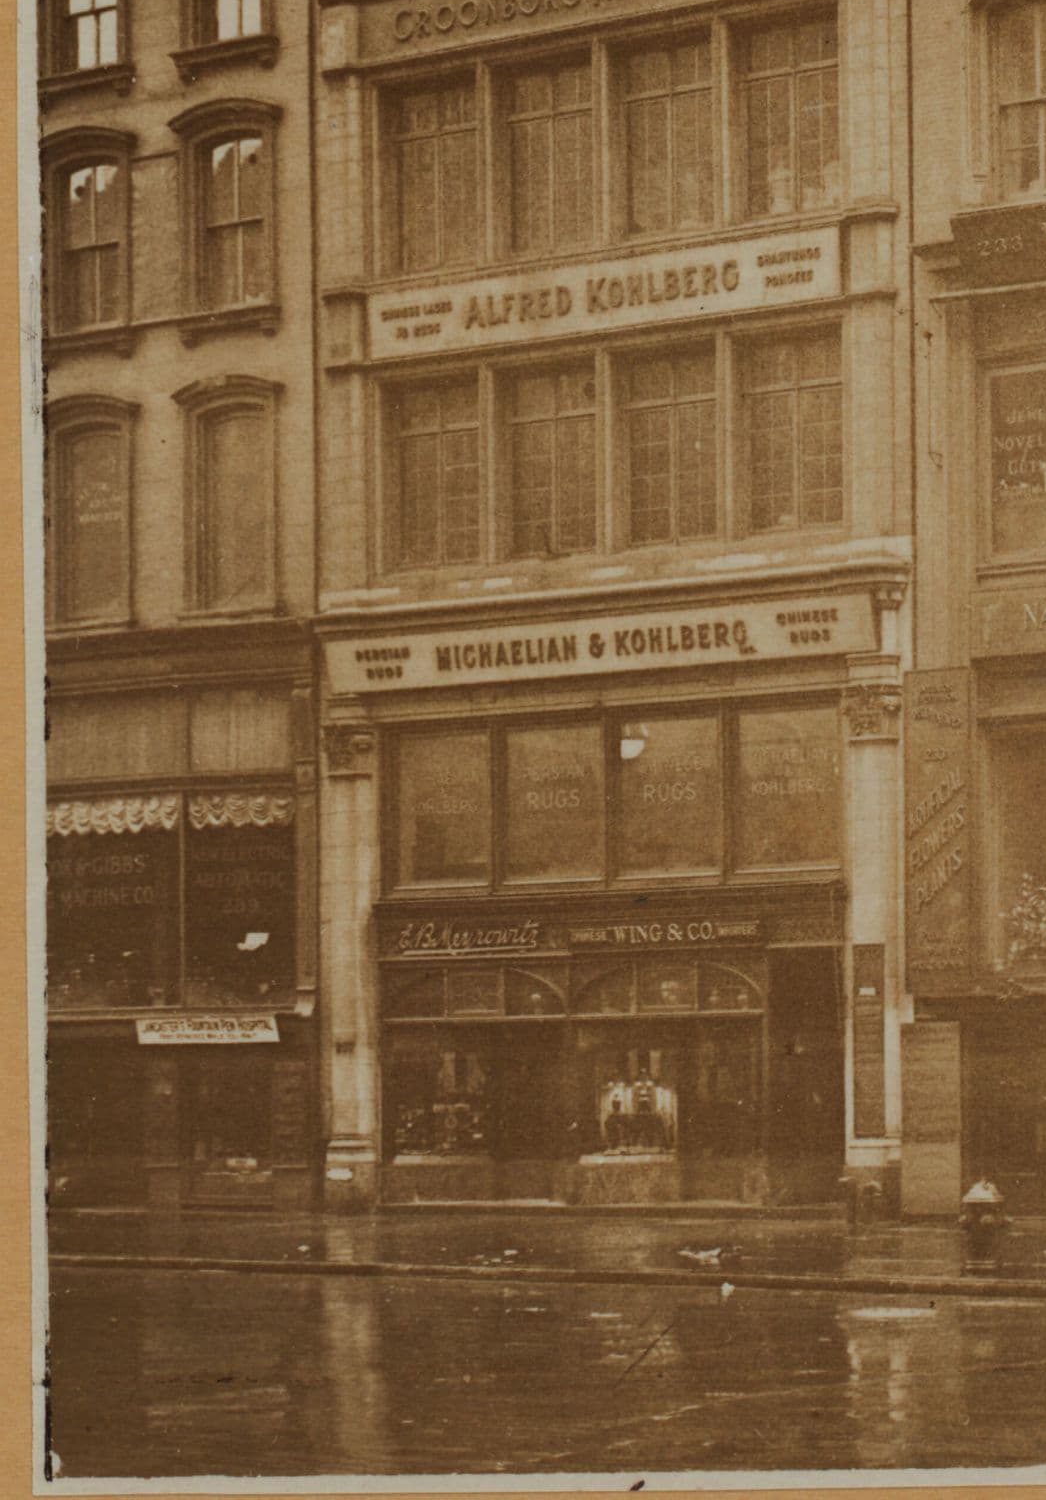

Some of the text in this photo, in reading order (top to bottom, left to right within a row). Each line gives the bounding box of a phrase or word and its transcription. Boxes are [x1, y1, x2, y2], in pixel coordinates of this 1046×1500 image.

[463, 259, 742, 332] ALFRED KOHLBERG
[435, 618, 750, 673] MICHAELIAN & KOHLBERG
[526, 789, 582, 811] RUGS
[643, 782, 698, 804] RUGS
[910, 804, 966, 876] FLOWERS
[916, 846, 963, 912] PLANTS
[613, 924, 664, 945] WING
[667, 923, 683, 942] &
[687, 921, 716, 941] CO.
